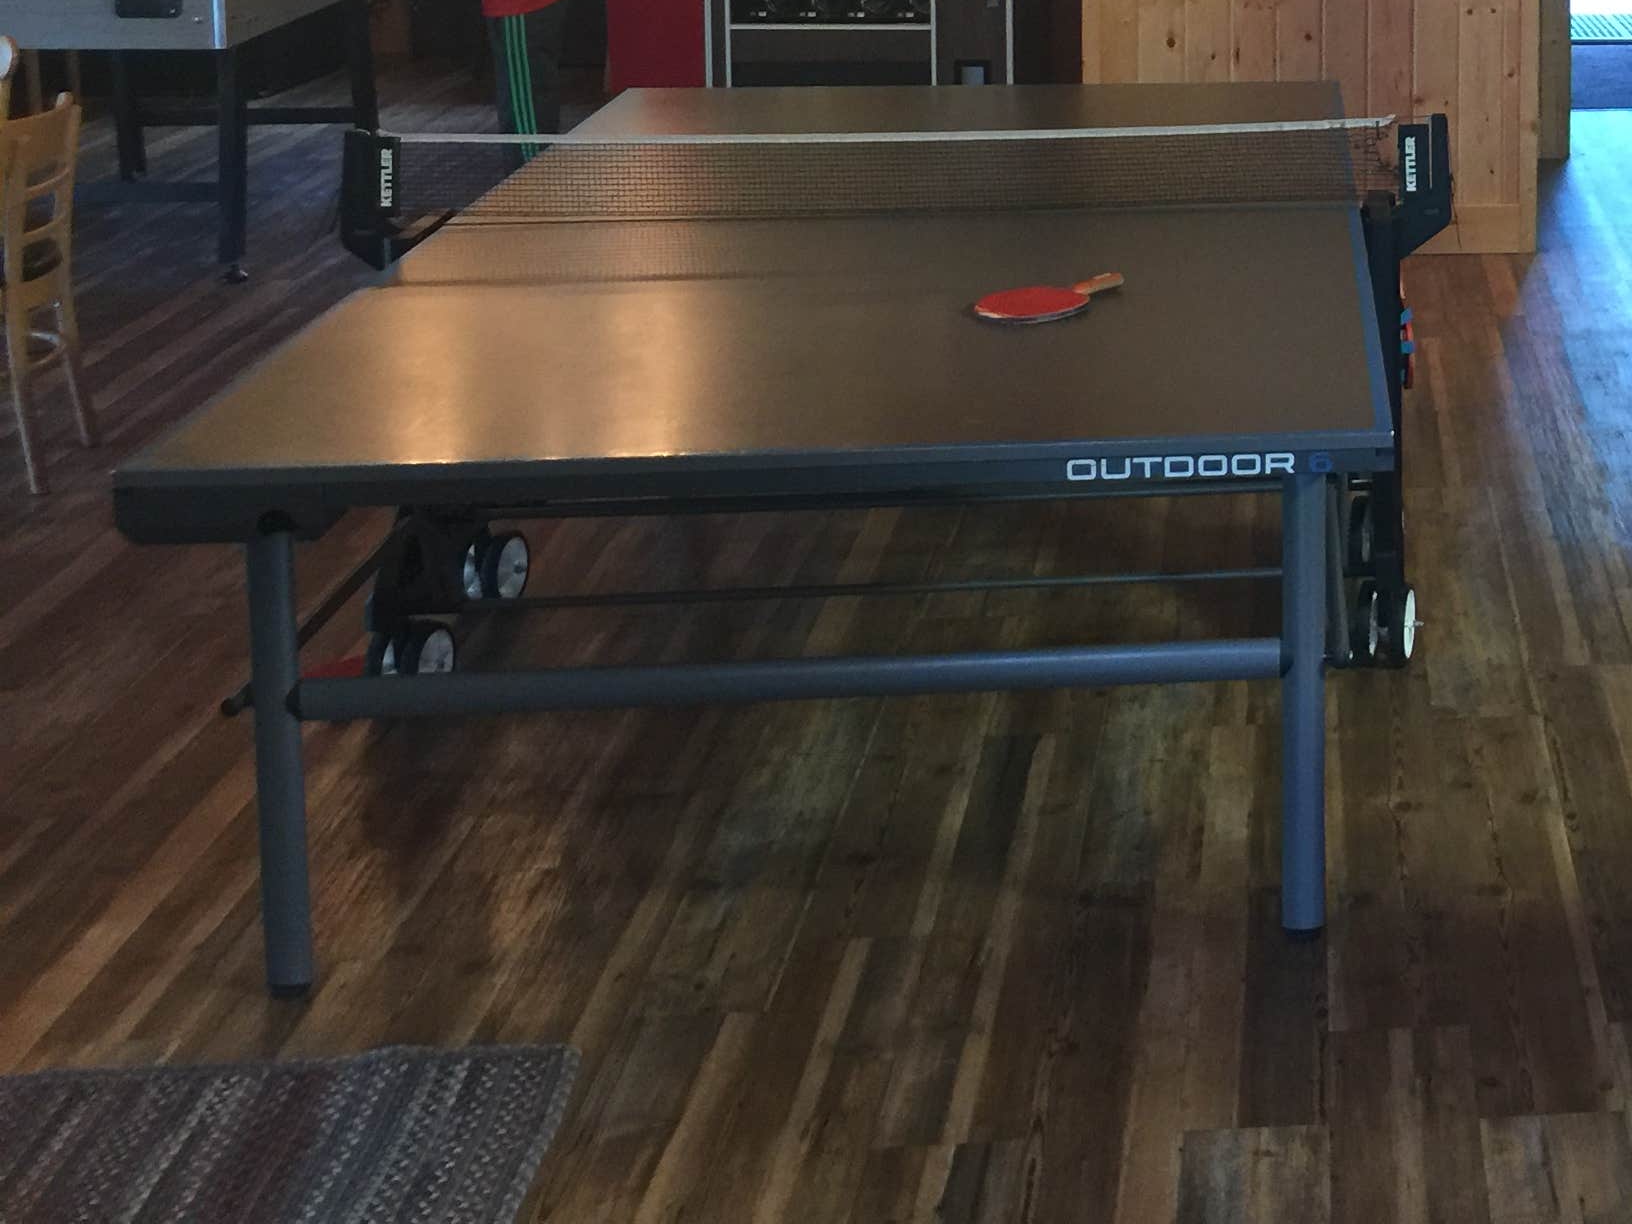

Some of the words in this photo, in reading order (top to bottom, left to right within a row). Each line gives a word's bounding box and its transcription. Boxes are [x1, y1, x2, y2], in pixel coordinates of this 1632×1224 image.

[380, 148, 393, 207] KETTLER
[1404, 136, 1417, 192] KETTLER
[1066, 452, 1295, 481] OUTDOOR
